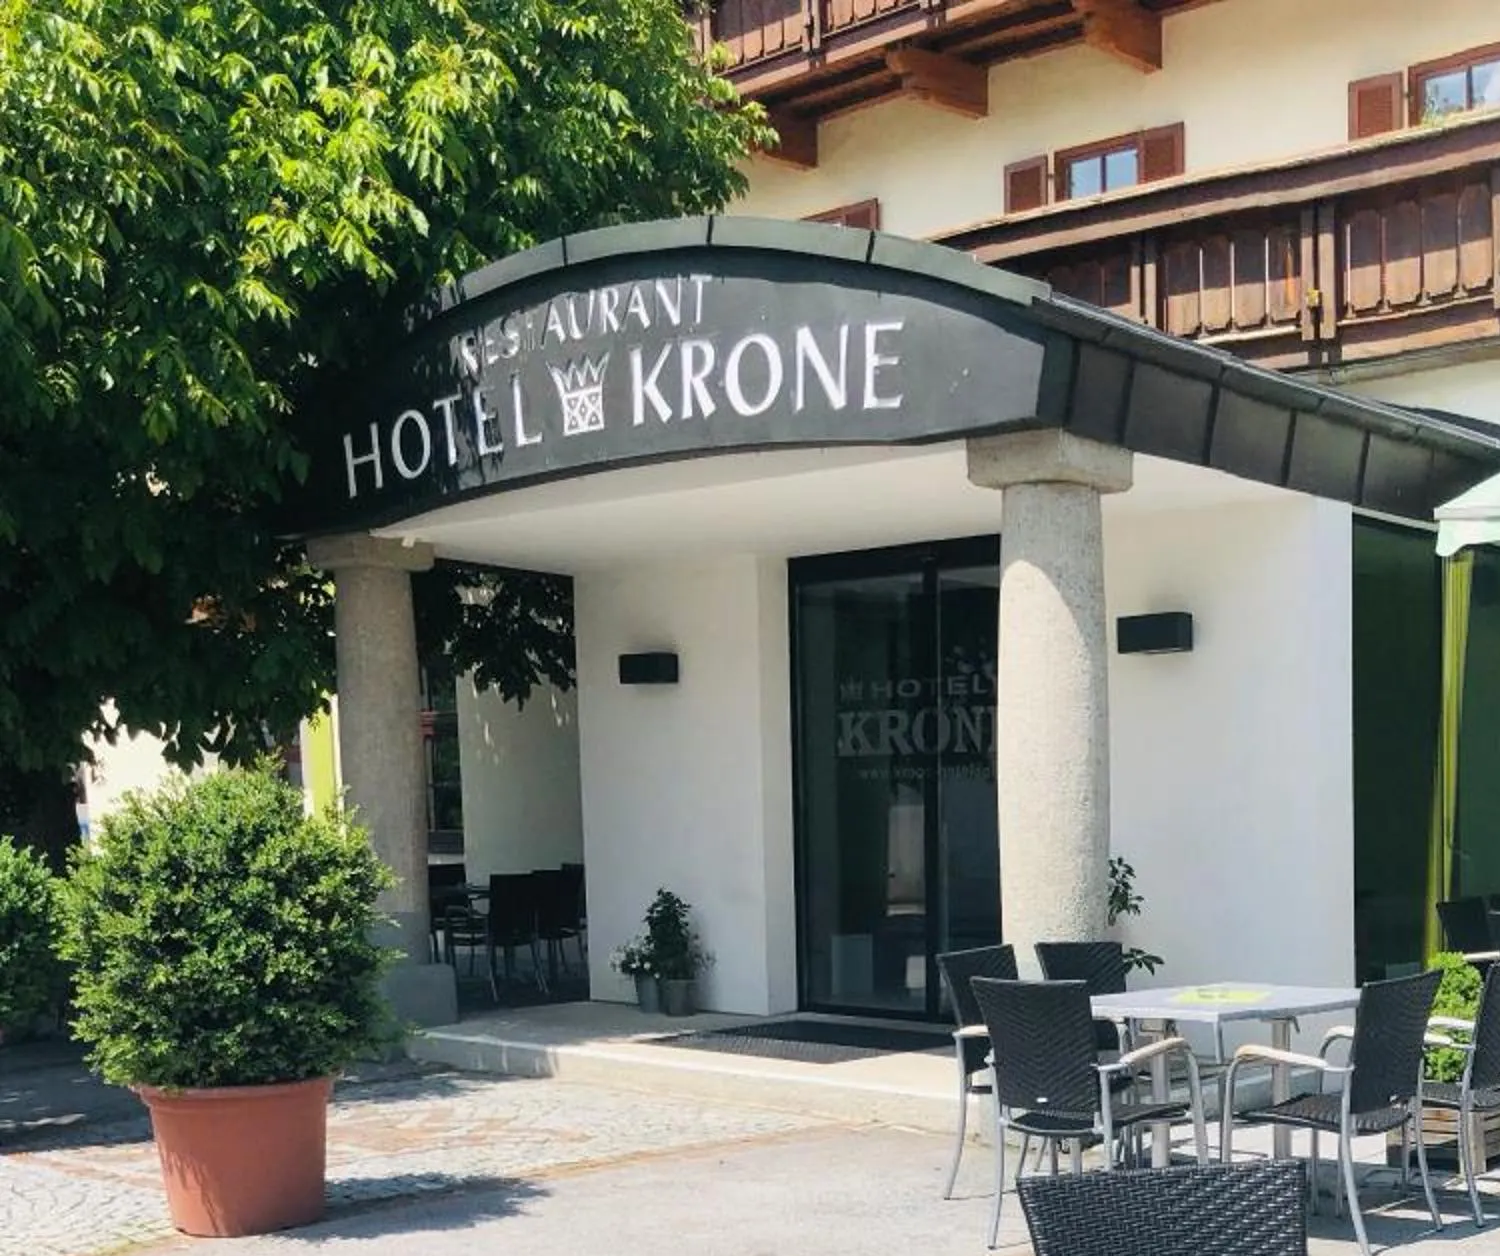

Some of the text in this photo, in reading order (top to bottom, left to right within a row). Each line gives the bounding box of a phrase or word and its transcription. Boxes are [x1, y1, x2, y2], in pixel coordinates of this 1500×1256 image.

[454, 274, 712, 376] RESAURANT
[343, 321, 904, 499] HOTEL KRONE
[871, 675, 989, 698] HOTEL
